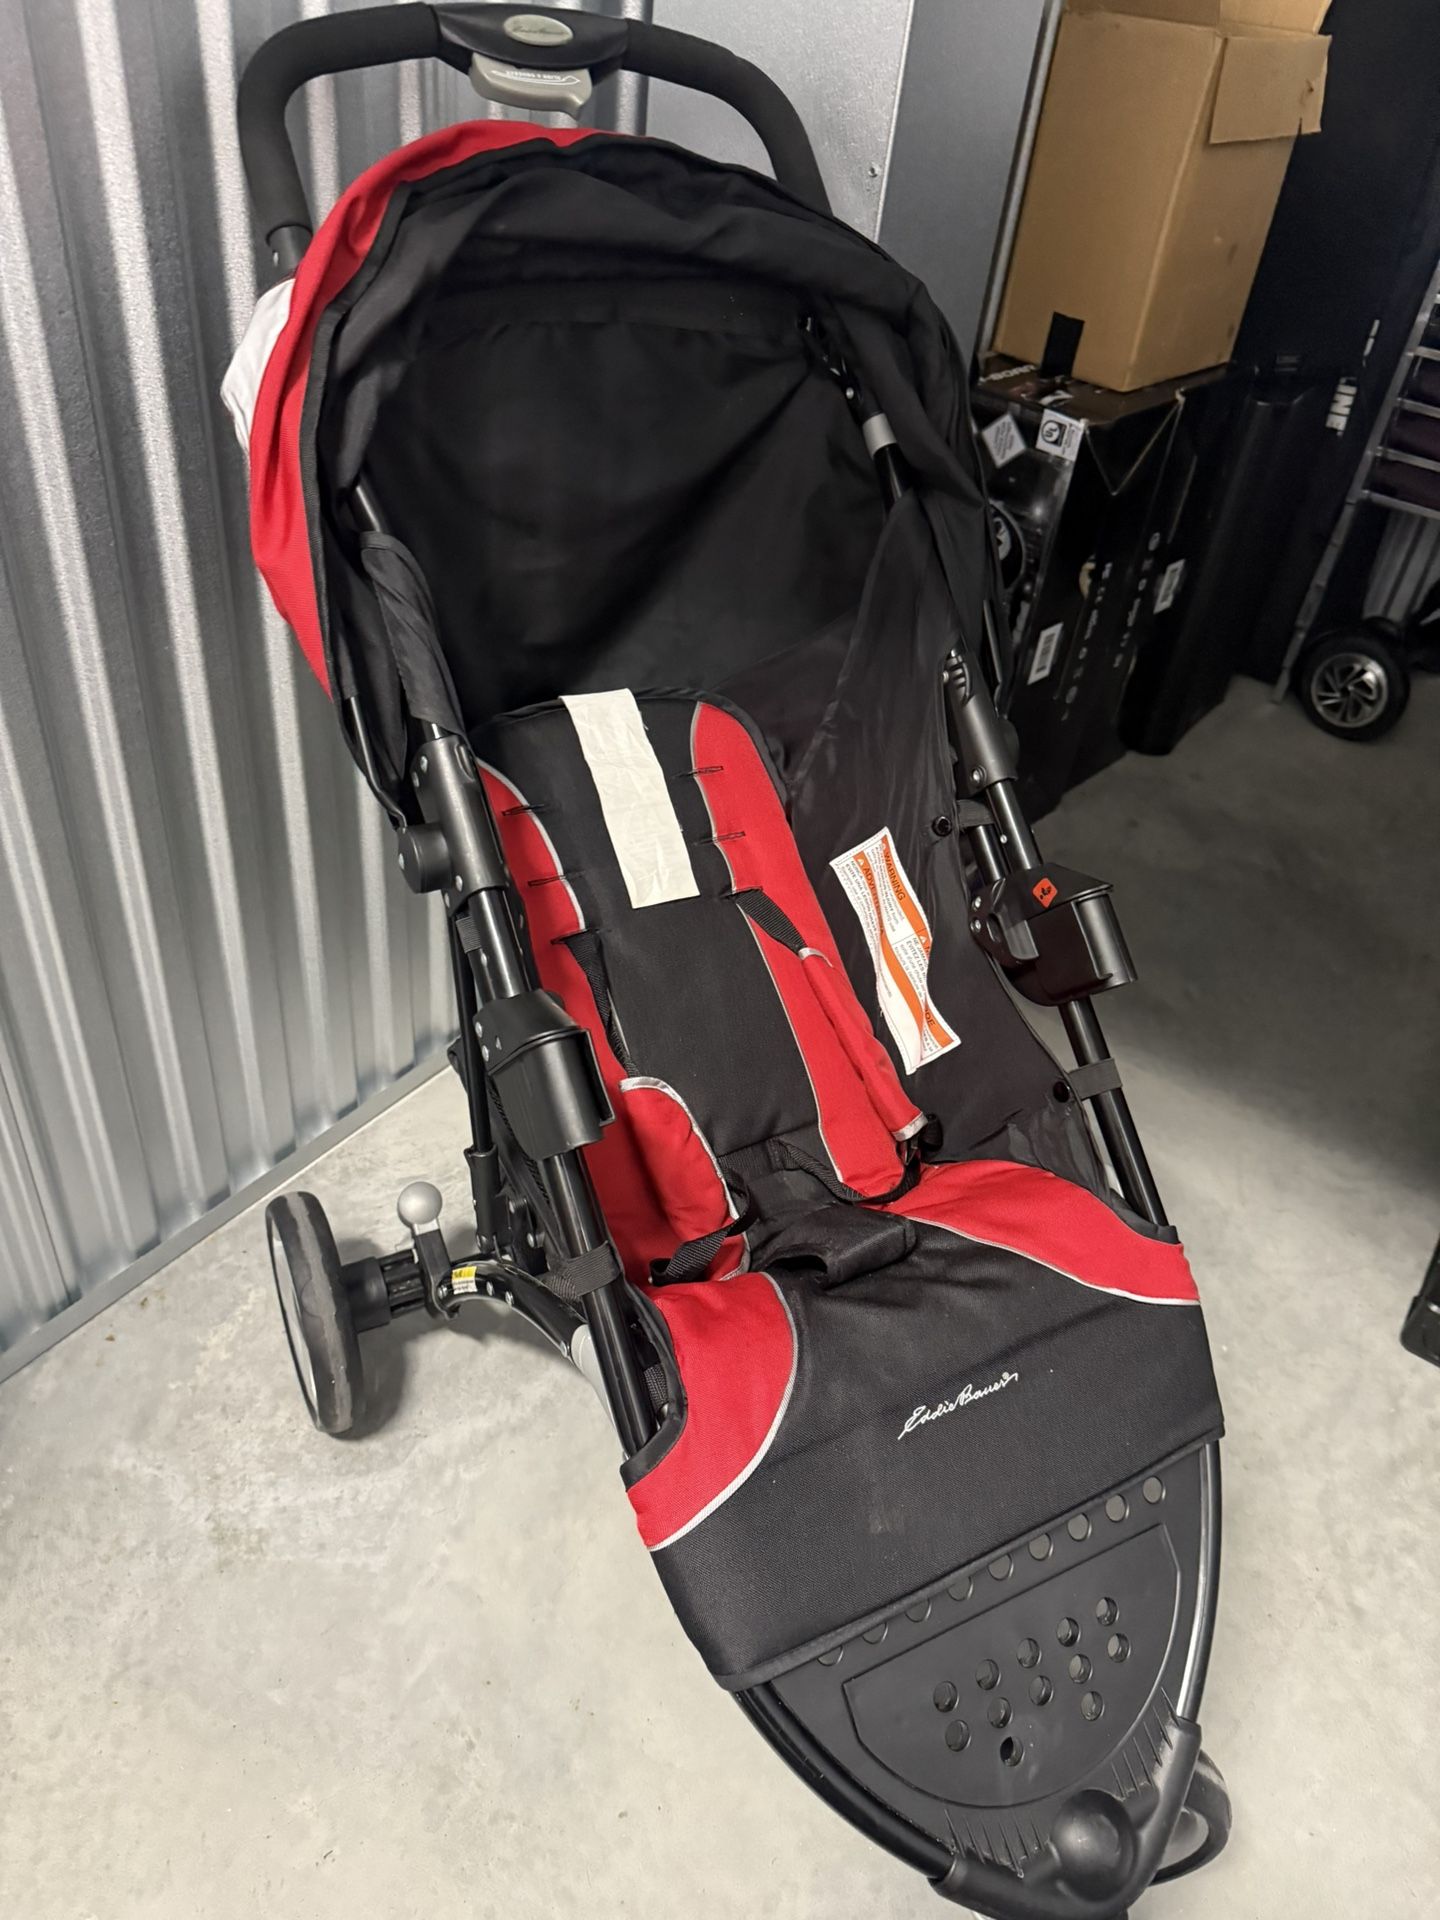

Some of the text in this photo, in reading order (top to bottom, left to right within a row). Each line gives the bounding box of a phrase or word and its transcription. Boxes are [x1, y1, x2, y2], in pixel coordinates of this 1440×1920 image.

[885, 852, 907, 901] WARNING
[897, 1372, 1018, 1440] Eddie Bauer
